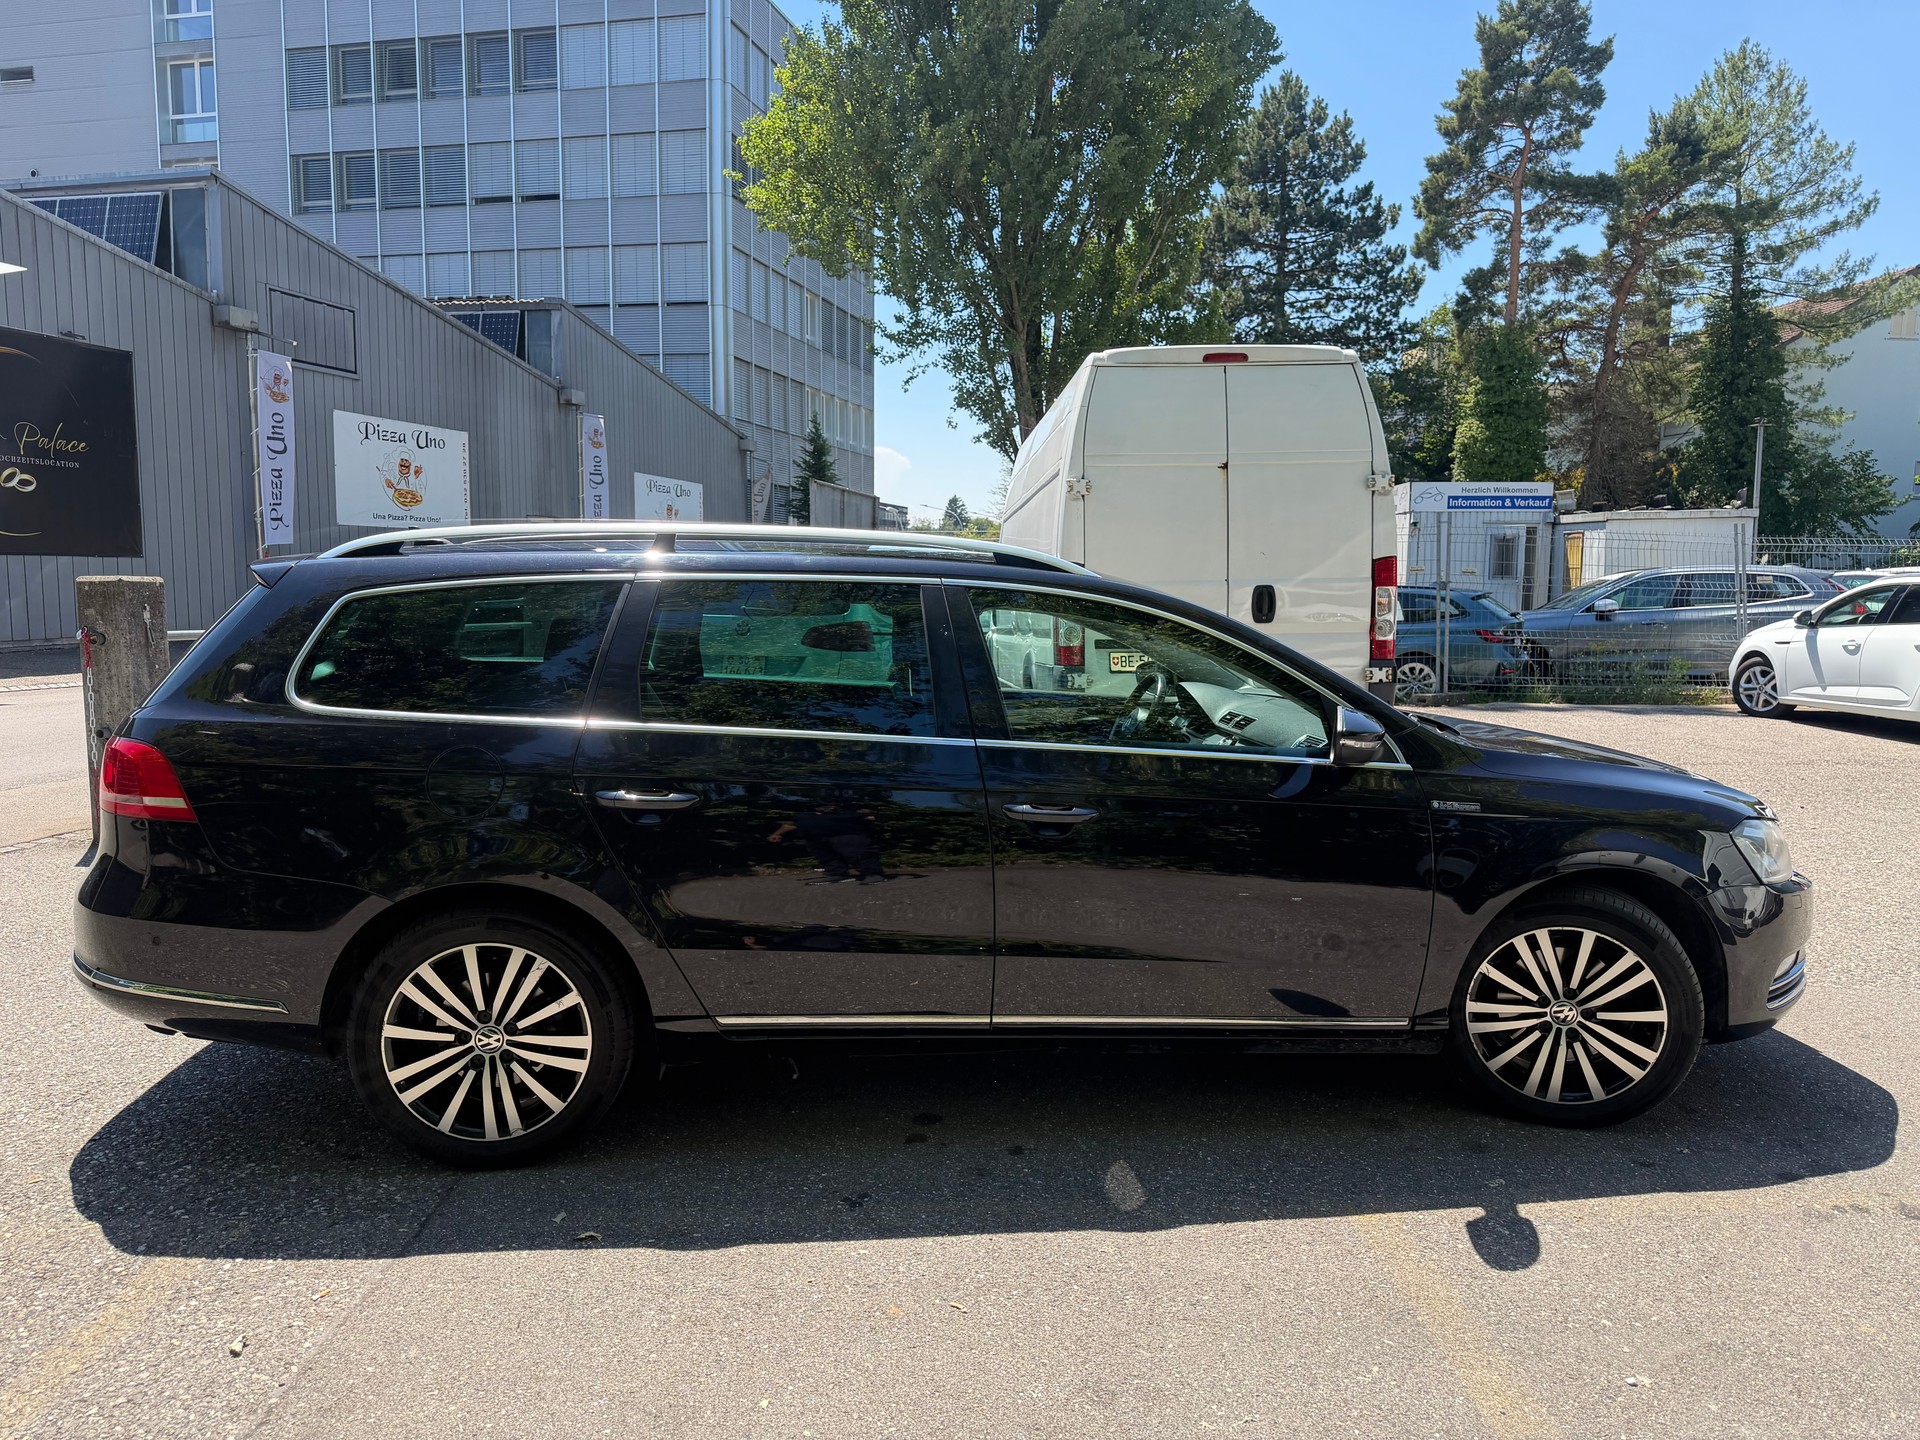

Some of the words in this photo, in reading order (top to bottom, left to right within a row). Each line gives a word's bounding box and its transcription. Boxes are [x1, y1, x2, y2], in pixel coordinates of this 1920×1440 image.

[14, 421, 89, 458] Palace
[267, 412, 288, 460] Uno
[357, 421, 407, 445] Pizza
[411, 430, 446, 450] Uno
[589, 455, 605, 489] Uno
[269, 467, 289, 531] Pizza
[646, 479, 671, 496] Pizza
[674, 484, 691, 498] Uno
[1461, 486, 1492, 494] Herzlich
[1493, 486, 1539, 494] Willkommen
[593, 494, 602, 518] zza
[1450, 498, 1502, 507] Information
[1504, 498, 1512, 507] &
[1514, 498, 1550, 507] Verkauf
[372, 512, 386, 520] Una
[388, 513, 408, 521] Pizza?
